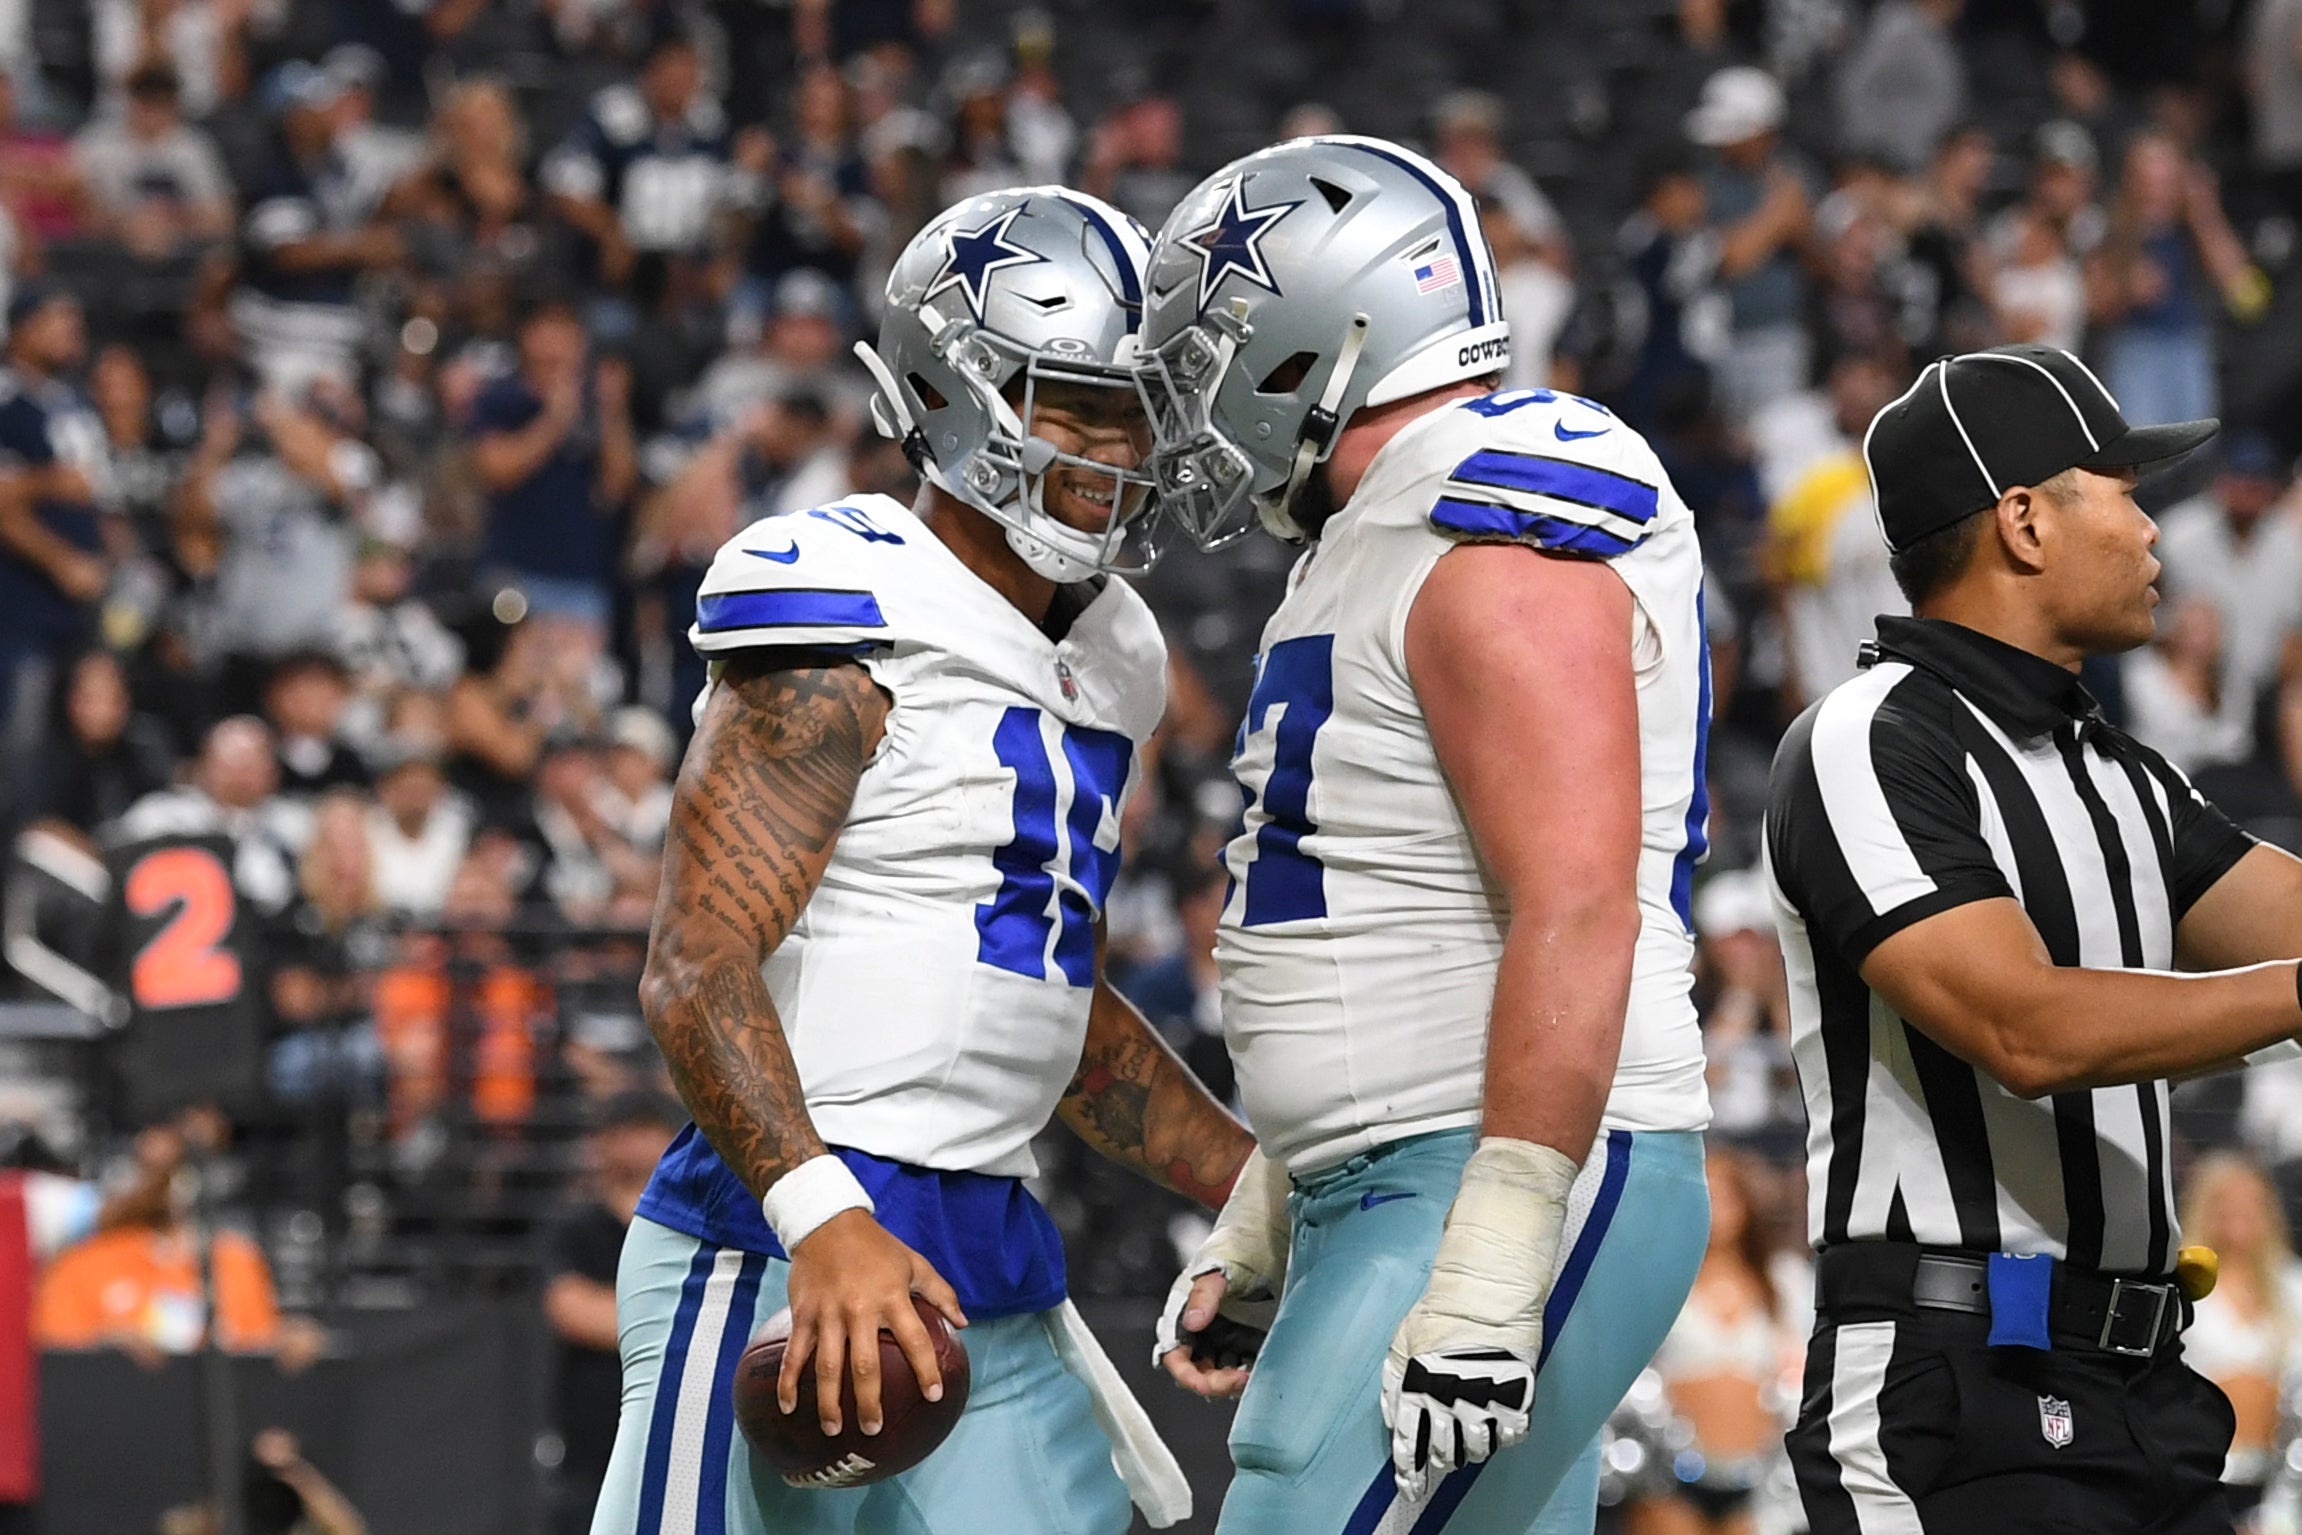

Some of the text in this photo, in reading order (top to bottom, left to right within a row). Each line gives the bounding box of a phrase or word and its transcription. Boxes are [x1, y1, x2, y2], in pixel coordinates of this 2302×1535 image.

[746, 880, 775, 906] you
[975, 706, 1134, 988] 15
[125, 846, 242, 1010] 2
[2047, 1417, 2069, 1440] NFL
